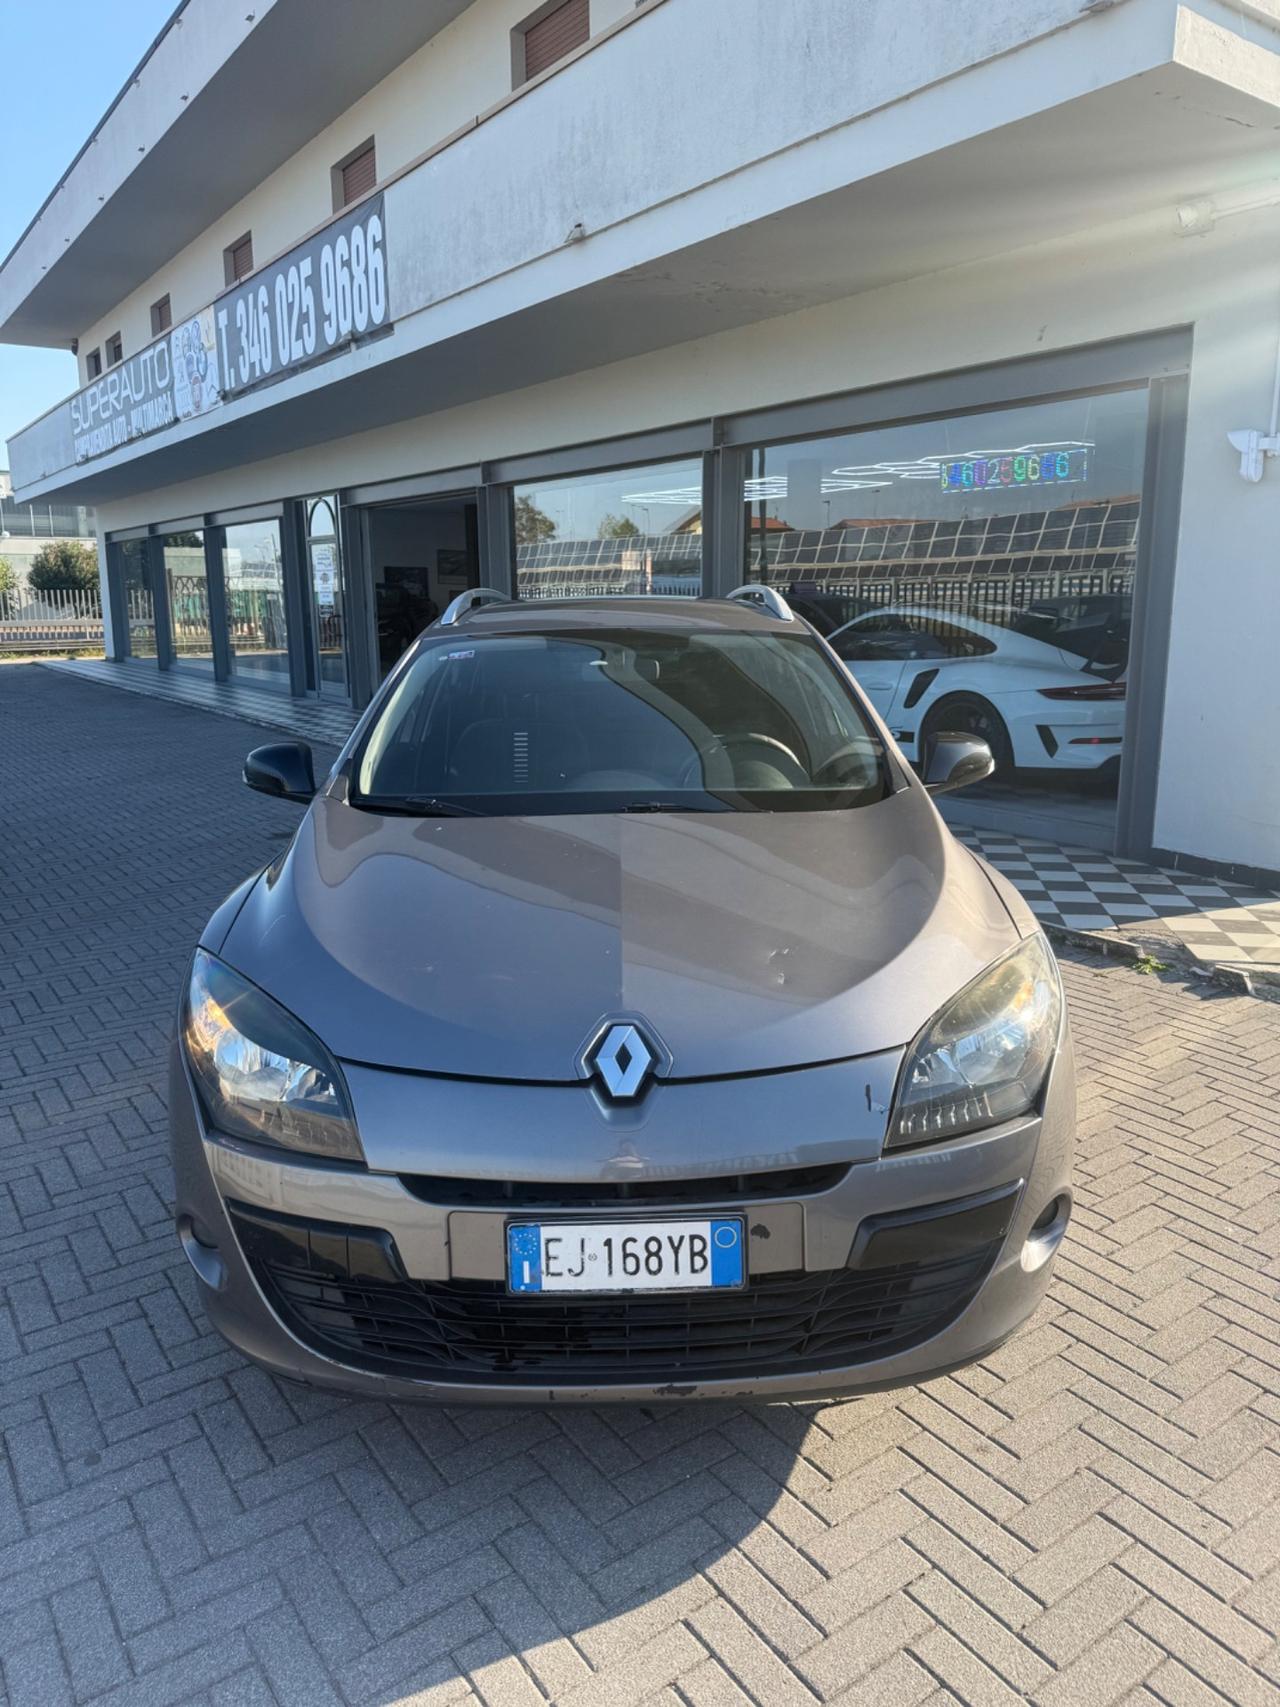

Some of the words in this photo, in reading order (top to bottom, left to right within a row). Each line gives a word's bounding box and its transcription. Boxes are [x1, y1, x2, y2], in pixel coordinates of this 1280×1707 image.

[218, 308, 235, 391] T.
[236, 285, 272, 384] 346
[275, 256, 316, 366] 025
[320, 214, 386, 346] 9686
[71, 341, 170, 436] SUPERAUTO
[543, 1237, 585, 1277] EJ
[603, 1234, 709, 1277] 168YB
